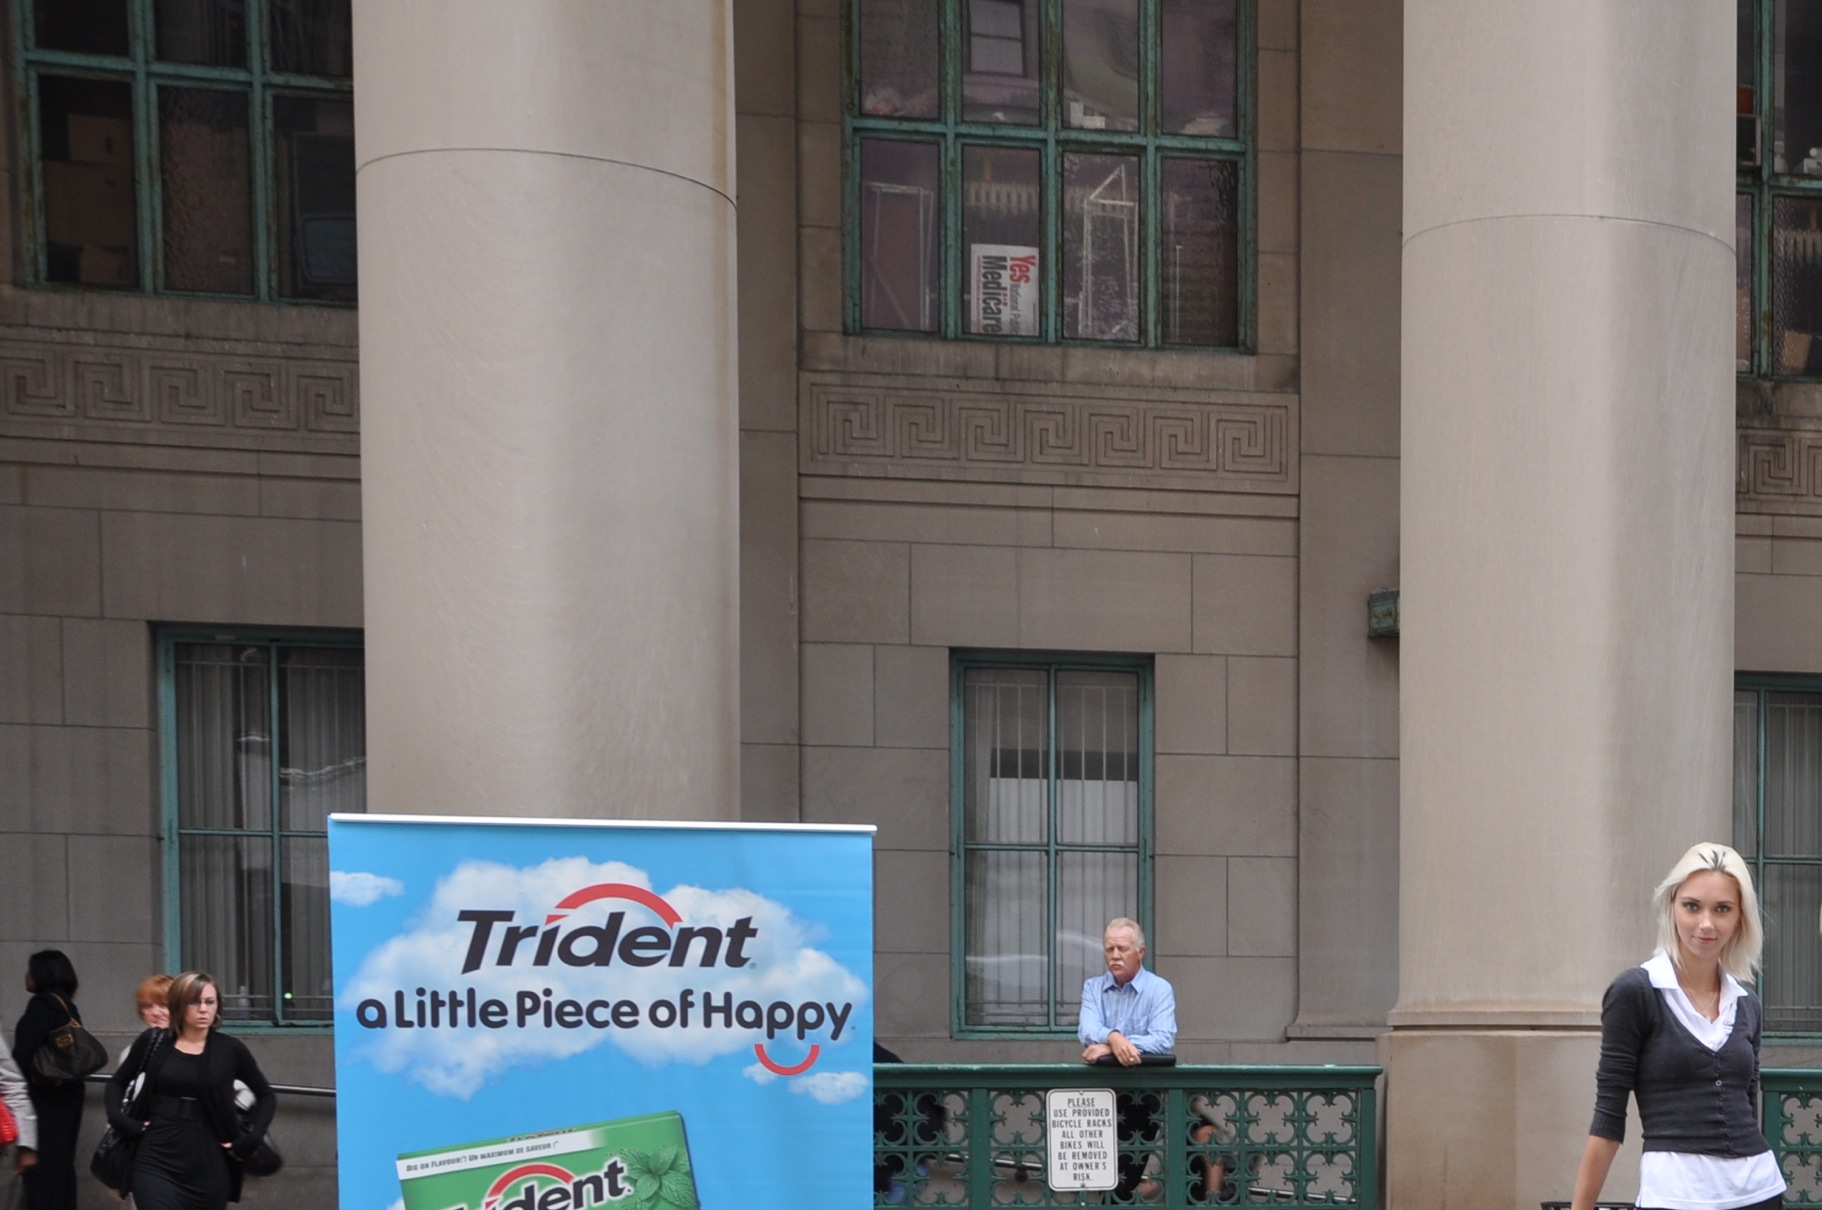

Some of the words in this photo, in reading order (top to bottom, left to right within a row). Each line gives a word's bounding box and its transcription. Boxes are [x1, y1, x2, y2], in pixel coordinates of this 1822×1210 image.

[1009, 255, 1036, 284] Yes
[982, 255, 1008, 334] Medicare
[457, 908, 759, 976] Trident
[356, 998, 387, 1029] a
[394, 987, 508, 1029] Little
[515, 988, 640, 1029] Piece
[648, 989, 695, 1029] of
[702, 991, 852, 1041] Happy
[1068, 1098, 1095, 1107] PLEASE
[1054, 1109, 1067, 1117] USE
[1072, 1108, 1110, 1117] PROVIDED
[1052, 1119, 1082, 1128] BICYCLE
[1087, 1119, 1112, 1128] RACKS
[1061, 1130, 1075, 1139] ALL
[1079, 1130, 1103, 1138] OTHER
[1060, 1141, 1082, 1149] BIKES
[1087, 1141, 1104, 1149] WILL
[1058, 1152, 1067, 1160] BE
[1072, 1151, 1107, 1160] REMOVED
[1059, 1162, 1068, 1170] AT
[1072, 1162, 1107, 1170] OWNER'S
